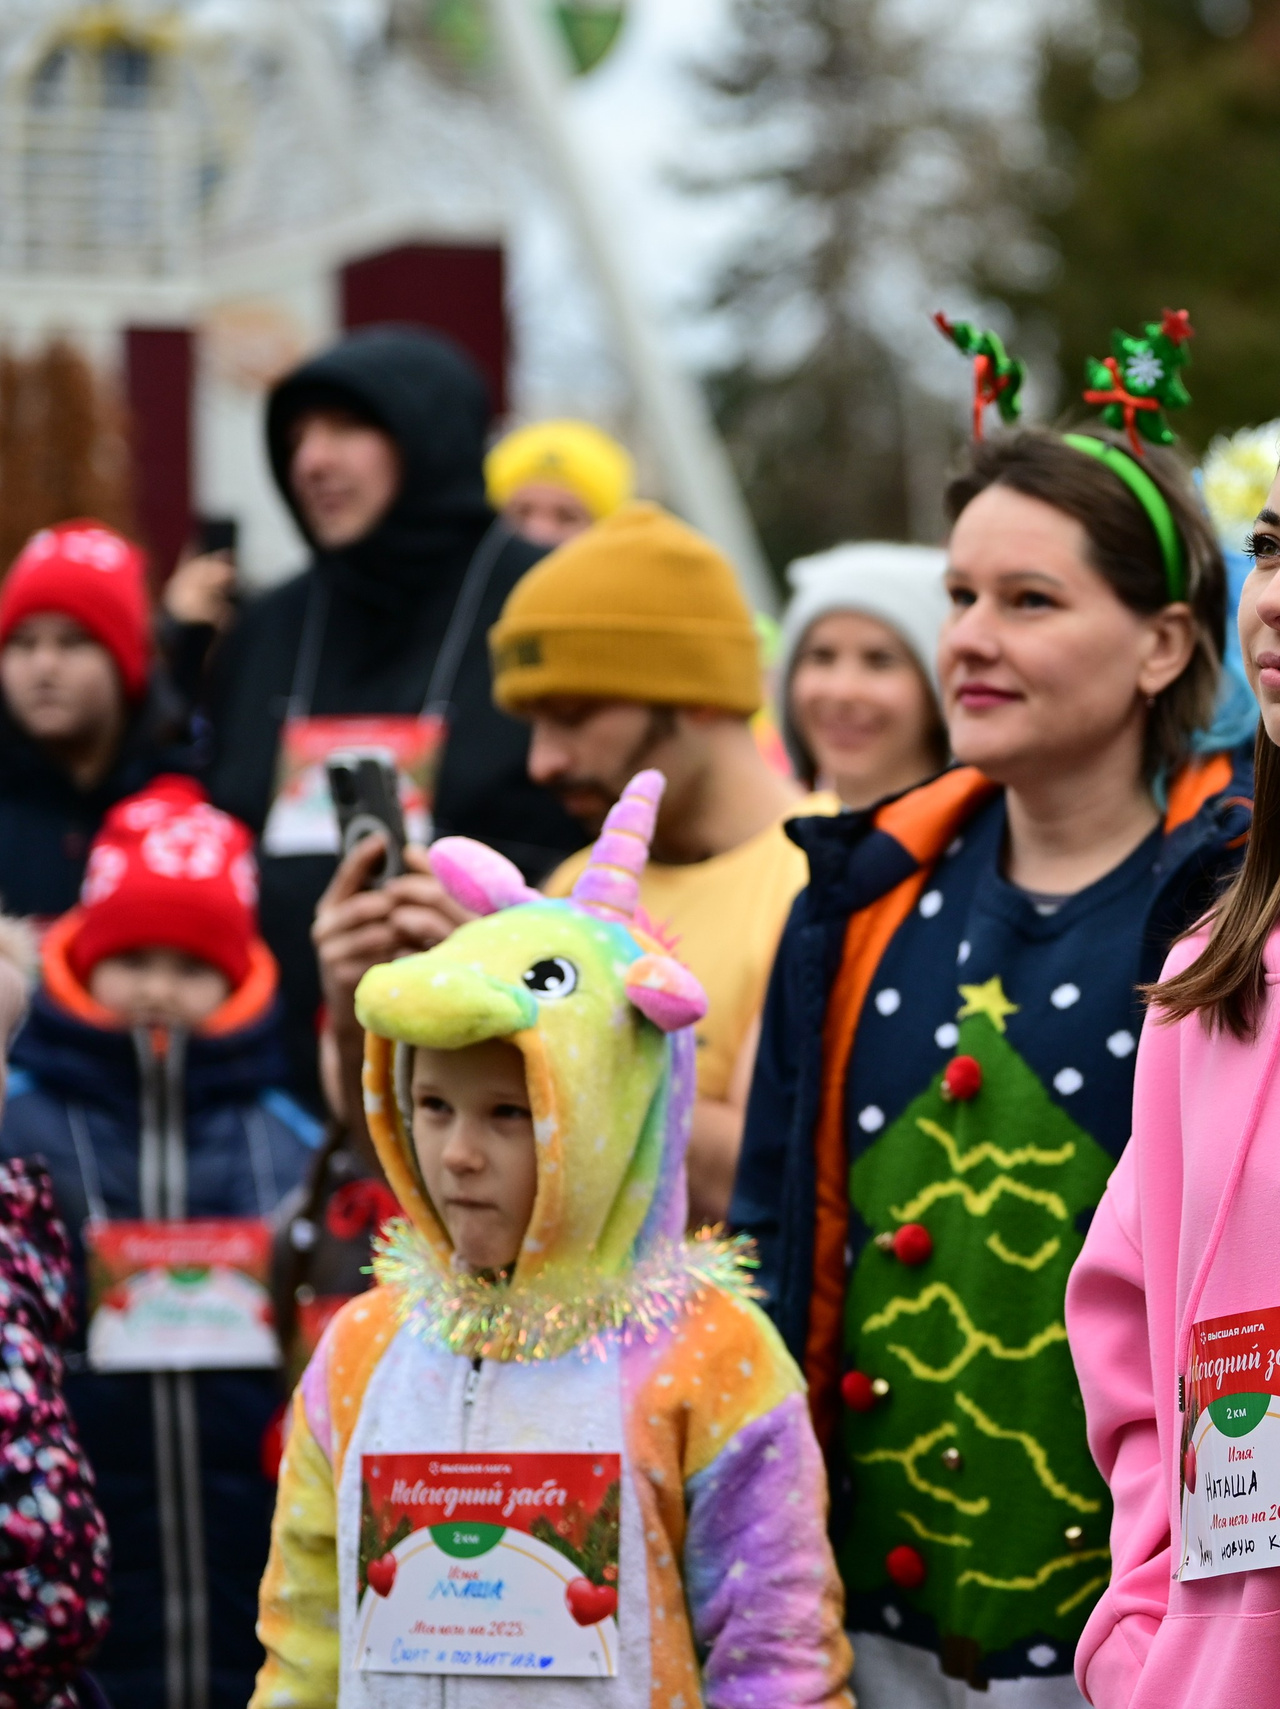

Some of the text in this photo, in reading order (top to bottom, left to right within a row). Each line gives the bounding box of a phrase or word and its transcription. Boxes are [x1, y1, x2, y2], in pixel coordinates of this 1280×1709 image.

[1207, 1323, 1265, 1341] ВЫСШАЯ ЛИГА
[1226, 1408, 1233, 1419] 2
[1228, 1446, 1255, 1463] Имя:
[391, 1478, 567, 1518] Новогодний забег
[1210, 1513, 1227, 1530] Моя
[1229, 1516, 1249, 1528] цель
[1251, 1511, 1267, 1527] на
[453, 1531, 462, 1545] 2
